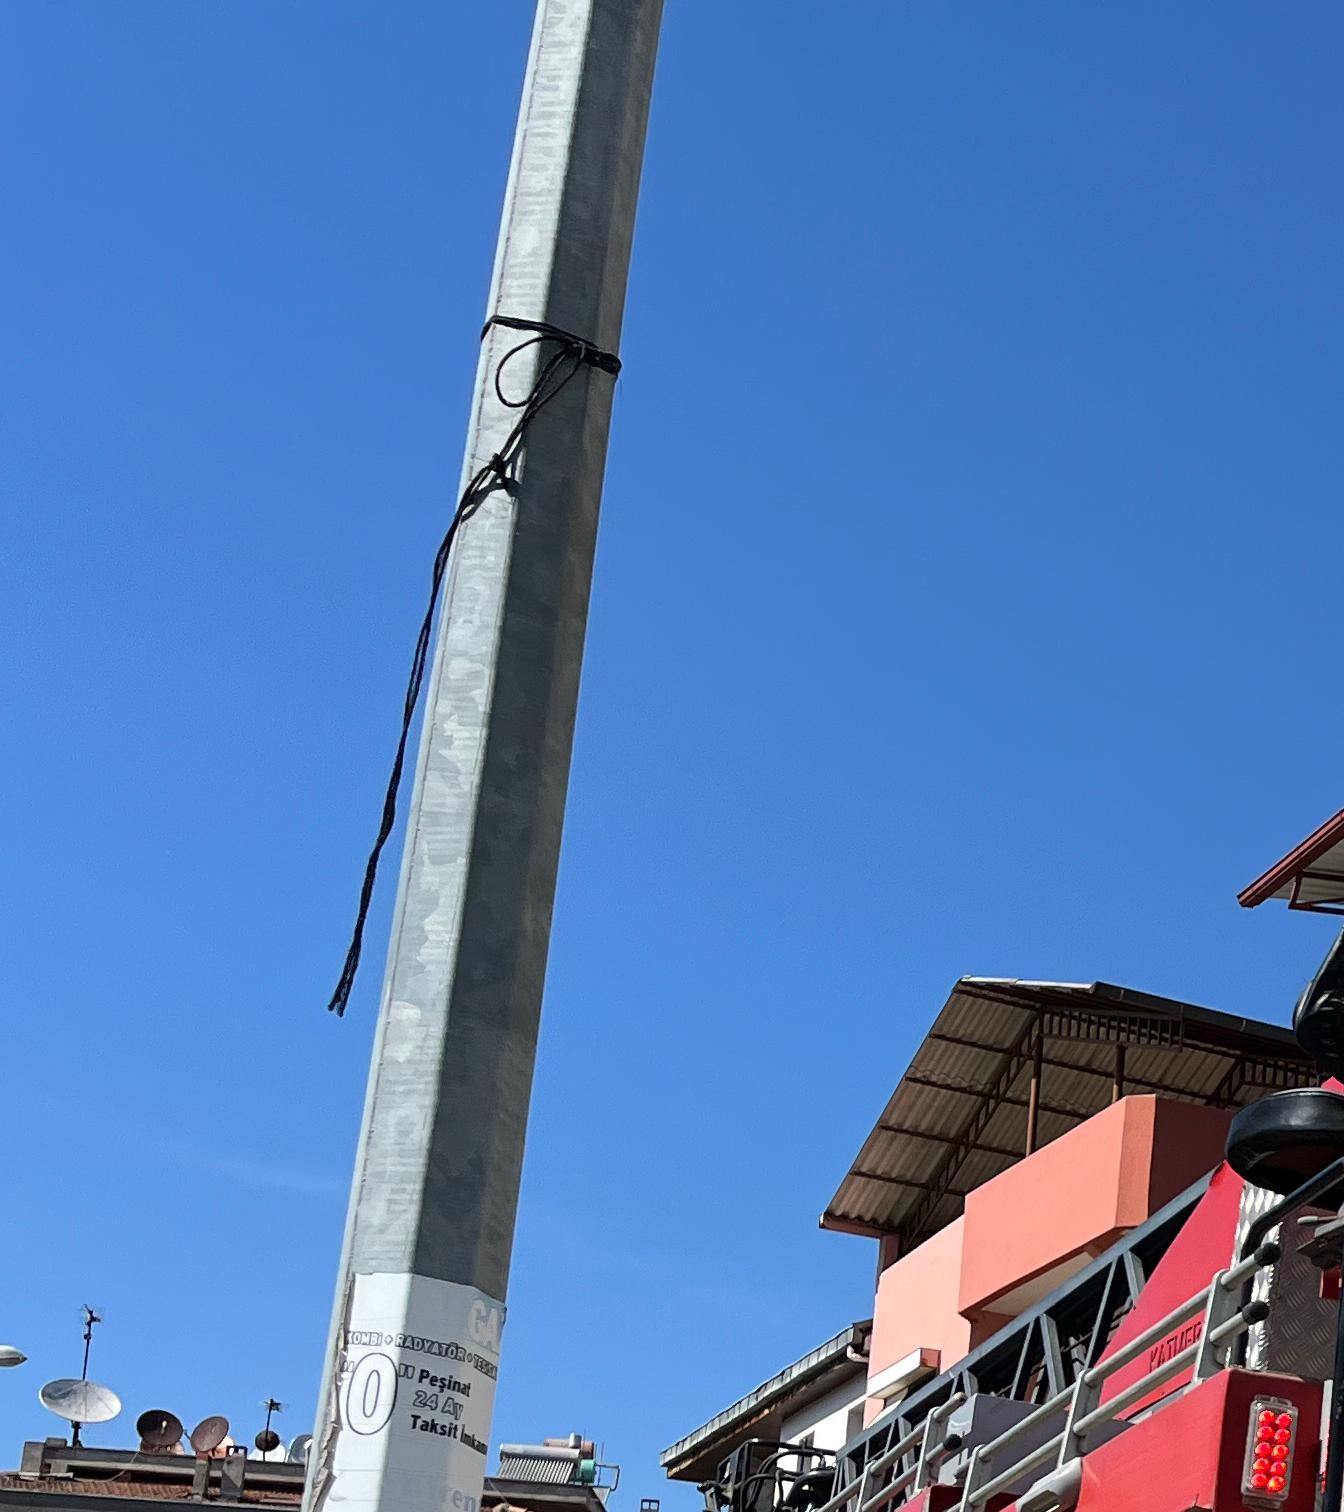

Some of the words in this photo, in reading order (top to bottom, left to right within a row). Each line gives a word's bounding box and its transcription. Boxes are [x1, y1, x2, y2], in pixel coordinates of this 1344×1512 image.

[395, 1334, 466, 1362] RADYATÖR
[418, 1369, 472, 1397] Peşinat
[412, 1390, 439, 1411] 24
[442, 1396, 464, 1420] Ay
[410, 1414, 460, 1439] Taksit
